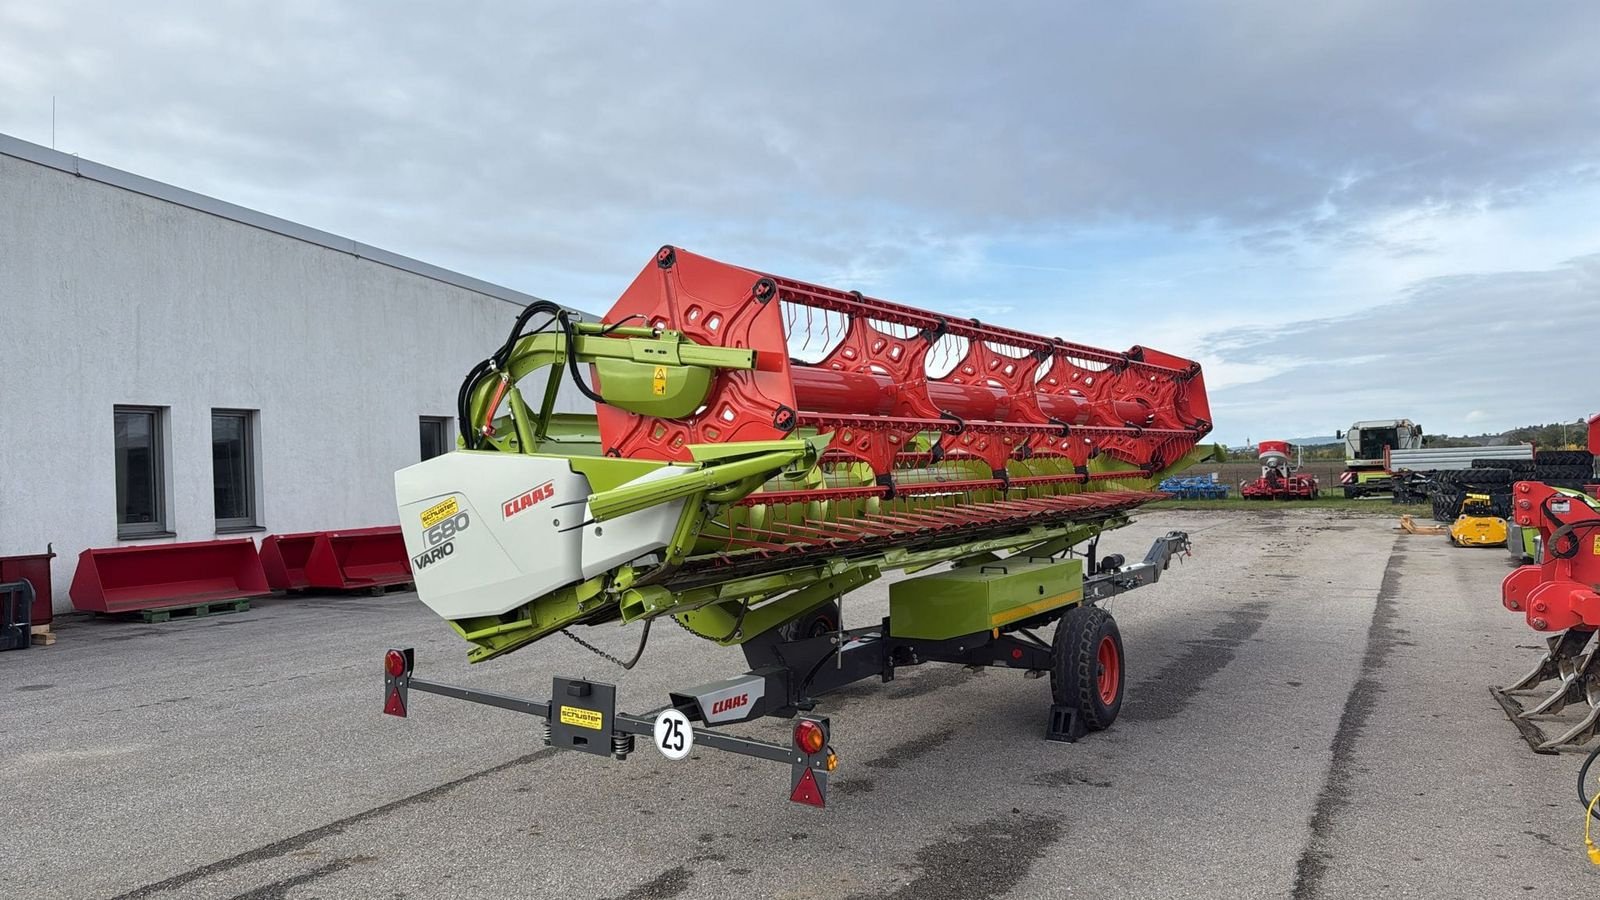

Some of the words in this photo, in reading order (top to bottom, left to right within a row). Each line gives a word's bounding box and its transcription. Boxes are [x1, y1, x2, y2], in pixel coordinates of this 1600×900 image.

[505, 483, 554, 517] CLAAS
[428, 512, 470, 546] 680
[414, 541, 454, 570] VARIO
[712, 693, 748, 715] CLAAS
[662, 717, 685, 752] 25
